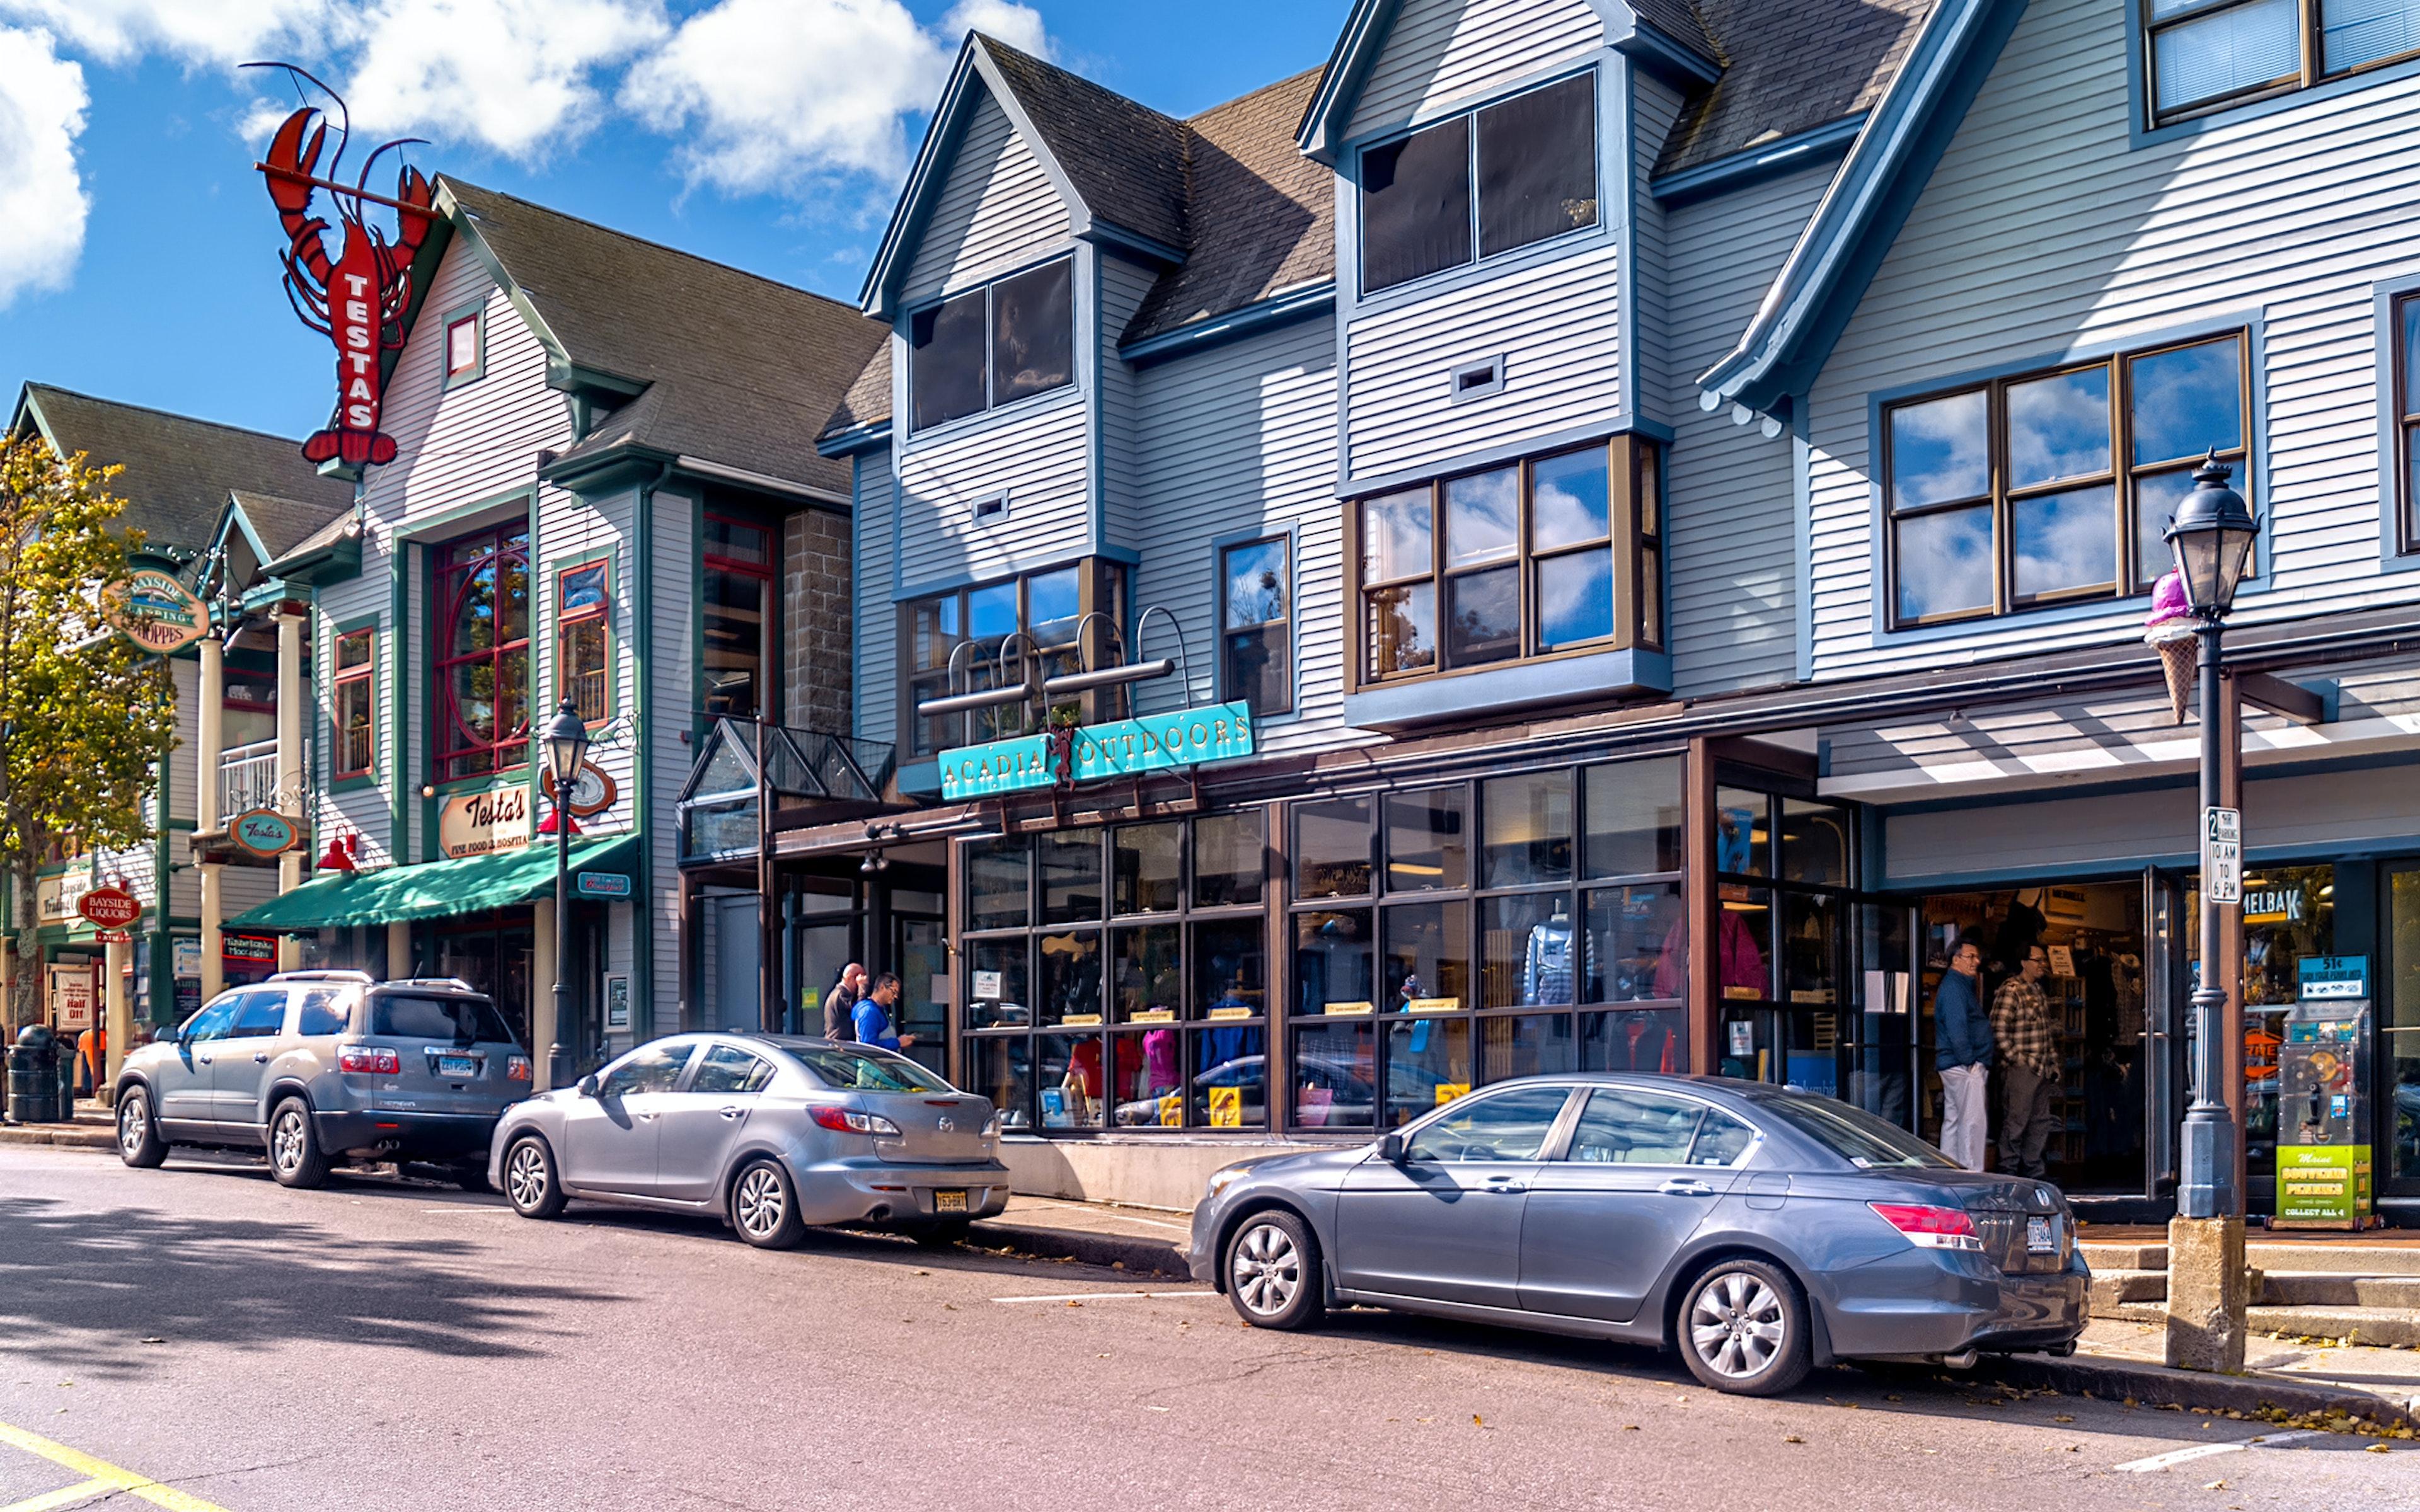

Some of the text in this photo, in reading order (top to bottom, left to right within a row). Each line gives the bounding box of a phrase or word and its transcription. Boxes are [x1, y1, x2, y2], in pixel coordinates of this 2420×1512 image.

[131, 576, 182, 598] BAYSIDE
[943, 716, 1248, 788] ACADIA OUTDOORS
[465, 789, 525, 828] Testa's
[2210, 813, 2218, 837] 2
[2218, 828, 2237, 839] PARKING
[468, 840, 488, 853] FOOD
[2212, 845, 2236, 860] 10 AM
[2219, 864, 2230, 879] TO
[2213, 881, 2236, 896] 6 PM
[89, 897, 132, 908] BAYSIDE
[89, 907, 132, 919] LIQUORS
[103, 934, 120, 942] ATM
[67, 999, 86, 1008] Half
[69, 1010, 84, 1019] Off
[2298, 1153, 2332, 1164] Maine
[2285, 1208, 2320, 1217] COLLECT
[2321, 1208, 2337, 1217] ALL
